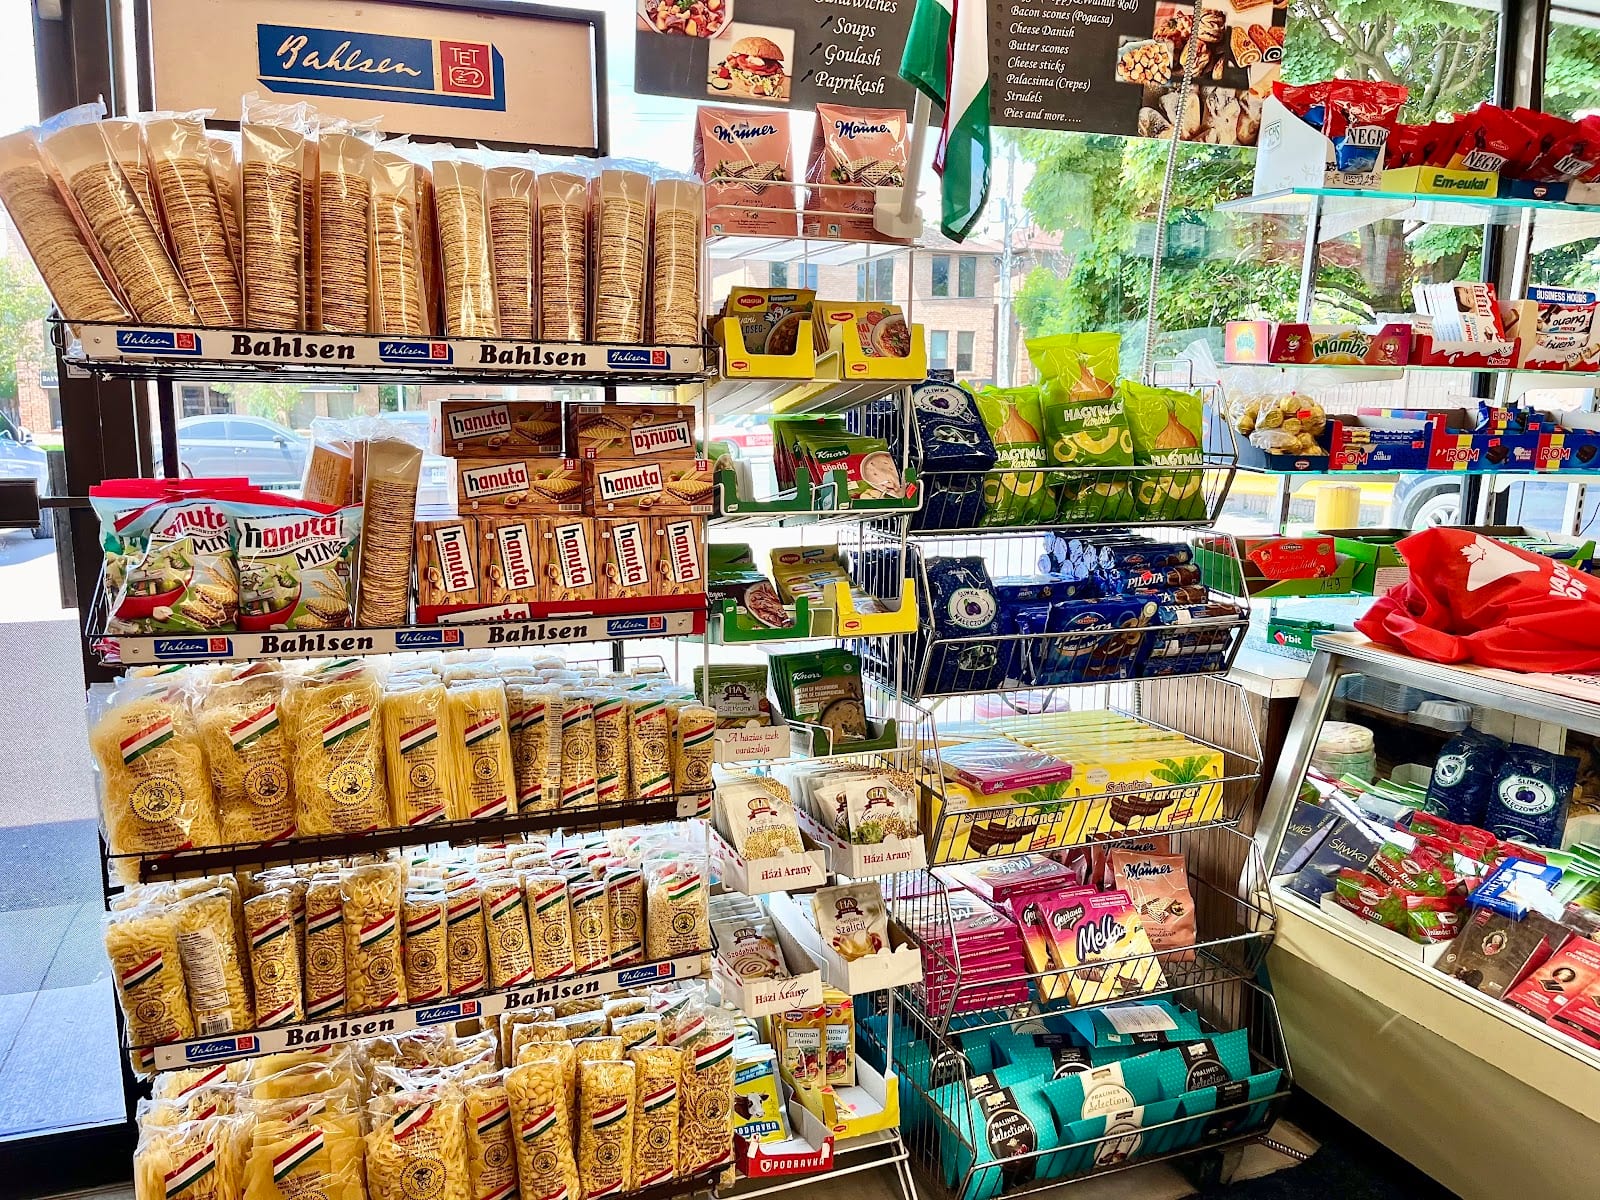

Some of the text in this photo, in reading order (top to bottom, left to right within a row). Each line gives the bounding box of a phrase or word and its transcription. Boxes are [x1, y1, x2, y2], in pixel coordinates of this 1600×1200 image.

[1010, 6, 1114, 27] Bacon scones (Pogacsa)
[833, 17, 876, 42] Soups
[1009, 22, 1075, 38] Cheese Danish
[276, 34, 422, 77] Bahlsen
[824, 44, 882, 66] Goulash
[1008, 39, 1070, 54] Butter scones
[449, 47, 480, 66] TET
[1007, 56, 1065, 74] Cheese sticks
[815, 71, 885, 96] Paprikash
[1006, 74, 1091, 92] Palacsinta (Crepes)
[1004, 90, 1042, 103] Strudels
[1003, 107, 1024, 118] Pies
[1025, 109, 1044, 119] and
[713, 123, 778, 143] Manner
[1463, 152, 1502, 170] NEGR
[1432, 174, 1489, 190] Em-eukal
[1536, 290, 1587, 303] BUSINESS HOURS
[122, 331, 172, 345] Bahlsen
[230, 334, 355, 359] Bahlsen
[382, 343, 426, 356] Bahlsen
[478, 345, 587, 366] Bahlsen
[611, 351, 648, 363] Bahlsen
[1314, 338, 1368, 359] Mamba
[452, 409, 508, 433] hanuta
[1064, 403, 1123, 421] HAGYMÁS
[1492, 410, 1513, 421] ROM
[634, 426, 688, 450] hanuta
[815, 449, 849, 459] Knorr
[1446, 448, 1479, 462] ROM
[1540, 447, 1570, 461] ROM
[468, 467, 526, 492] hanuta
[603, 469, 660, 494] hanuta
[244, 516, 336, 548] hanuta
[295, 540, 346, 571] MINIS
[442, 529, 468, 588] hanuta
[504, 528, 528, 585] hanuta
[562, 527, 586, 585] hanuta
[619, 527, 643, 584] hanuta
[672, 525, 694, 581] hanuta
[488, 622, 588, 643] Bahlsen
[610, 620, 645, 630] Bahlsen
[260, 634, 374, 654] Bahlsen
[399, 632, 440, 642] Bahlsen
[1273, 630, 1302, 645] rbit
[159, 642, 205, 652] Bahlsen
[792, 672, 821, 681] Knorr
[1517, 777, 1545, 789] ŚLIWKA
[1501, 792, 1548, 814] NAŁĘCZOWSKA
[1007, 811, 1063, 829] Bananen
[863, 850, 912, 864] Házi Arany
[1328, 838, 1368, 863] Śliwka
[761, 864, 812, 881] Házi Arany
[1124, 863, 1173, 879] Manner
[1399, 872, 1418, 889] Rum
[840, 900, 855, 909] HA
[1362, 906, 1383, 921] Rum
[1078, 914, 1127, 960] Mella
[622, 971, 654, 980] Bahlsen
[505, 979, 600, 1010] Bahlsen
[419, 1010, 458, 1021] Bahlsen
[286, 1018, 395, 1046] Bahlsen
[190, 1043, 232, 1056] Bahlsen
[1192, 1066, 1219, 1078] PRALINES
[1088, 1096, 1129, 1112] Selection
[1091, 1089, 1120, 1101] PRALINES
[991, 1115, 1019, 1129] PRALINES
[990, 1122, 1030, 1144] Selection
[773, 1157, 825, 1169] PODRAVKA
